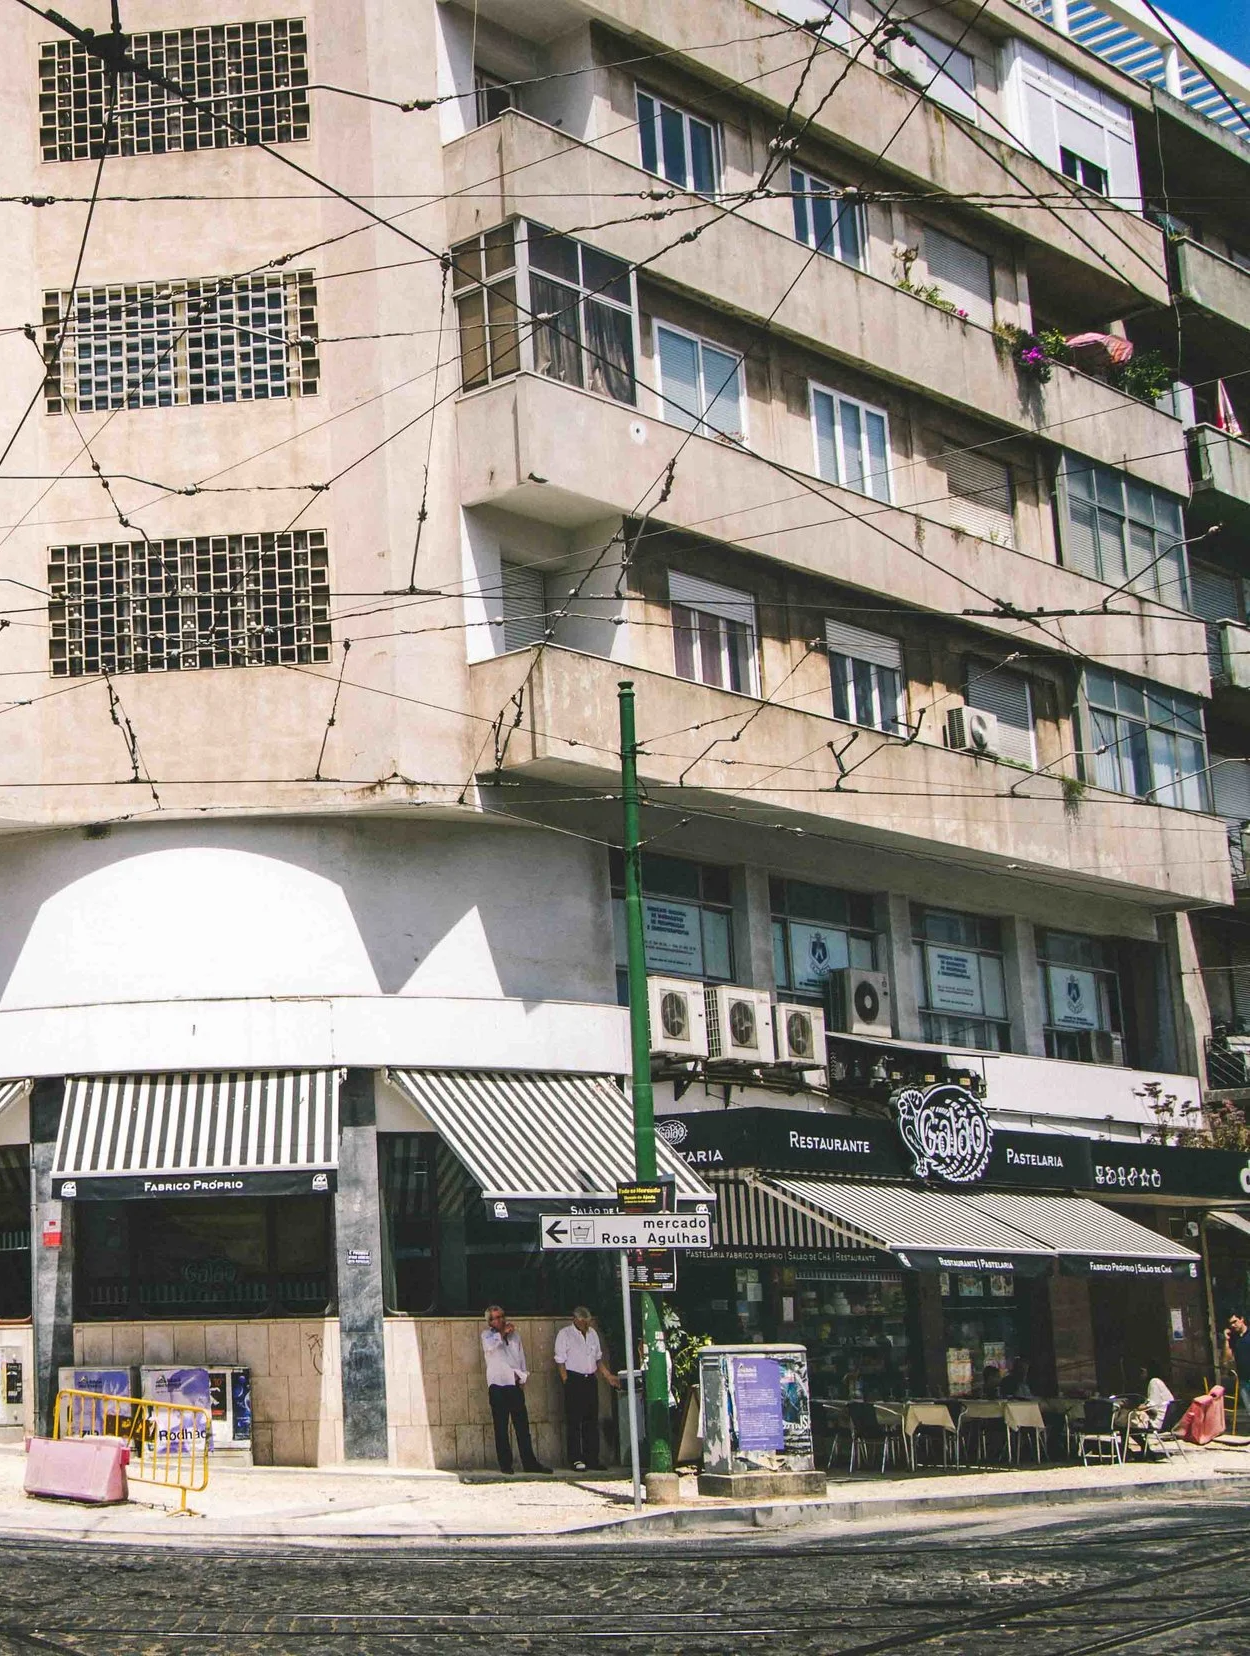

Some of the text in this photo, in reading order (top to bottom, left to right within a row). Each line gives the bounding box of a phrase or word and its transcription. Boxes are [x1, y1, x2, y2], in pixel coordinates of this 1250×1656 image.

[920, 1106, 986, 1158] Galão
[789, 1130, 870, 1154] RESTAURANTE
[1006, 1148, 1064, 1168] PASTELARIA
[144, 1178, 243, 1192] FABRICO PRÓPRIO
[643, 1217, 707, 1229] mercado
[602, 1233, 707, 1246] Rosa Agulhas
